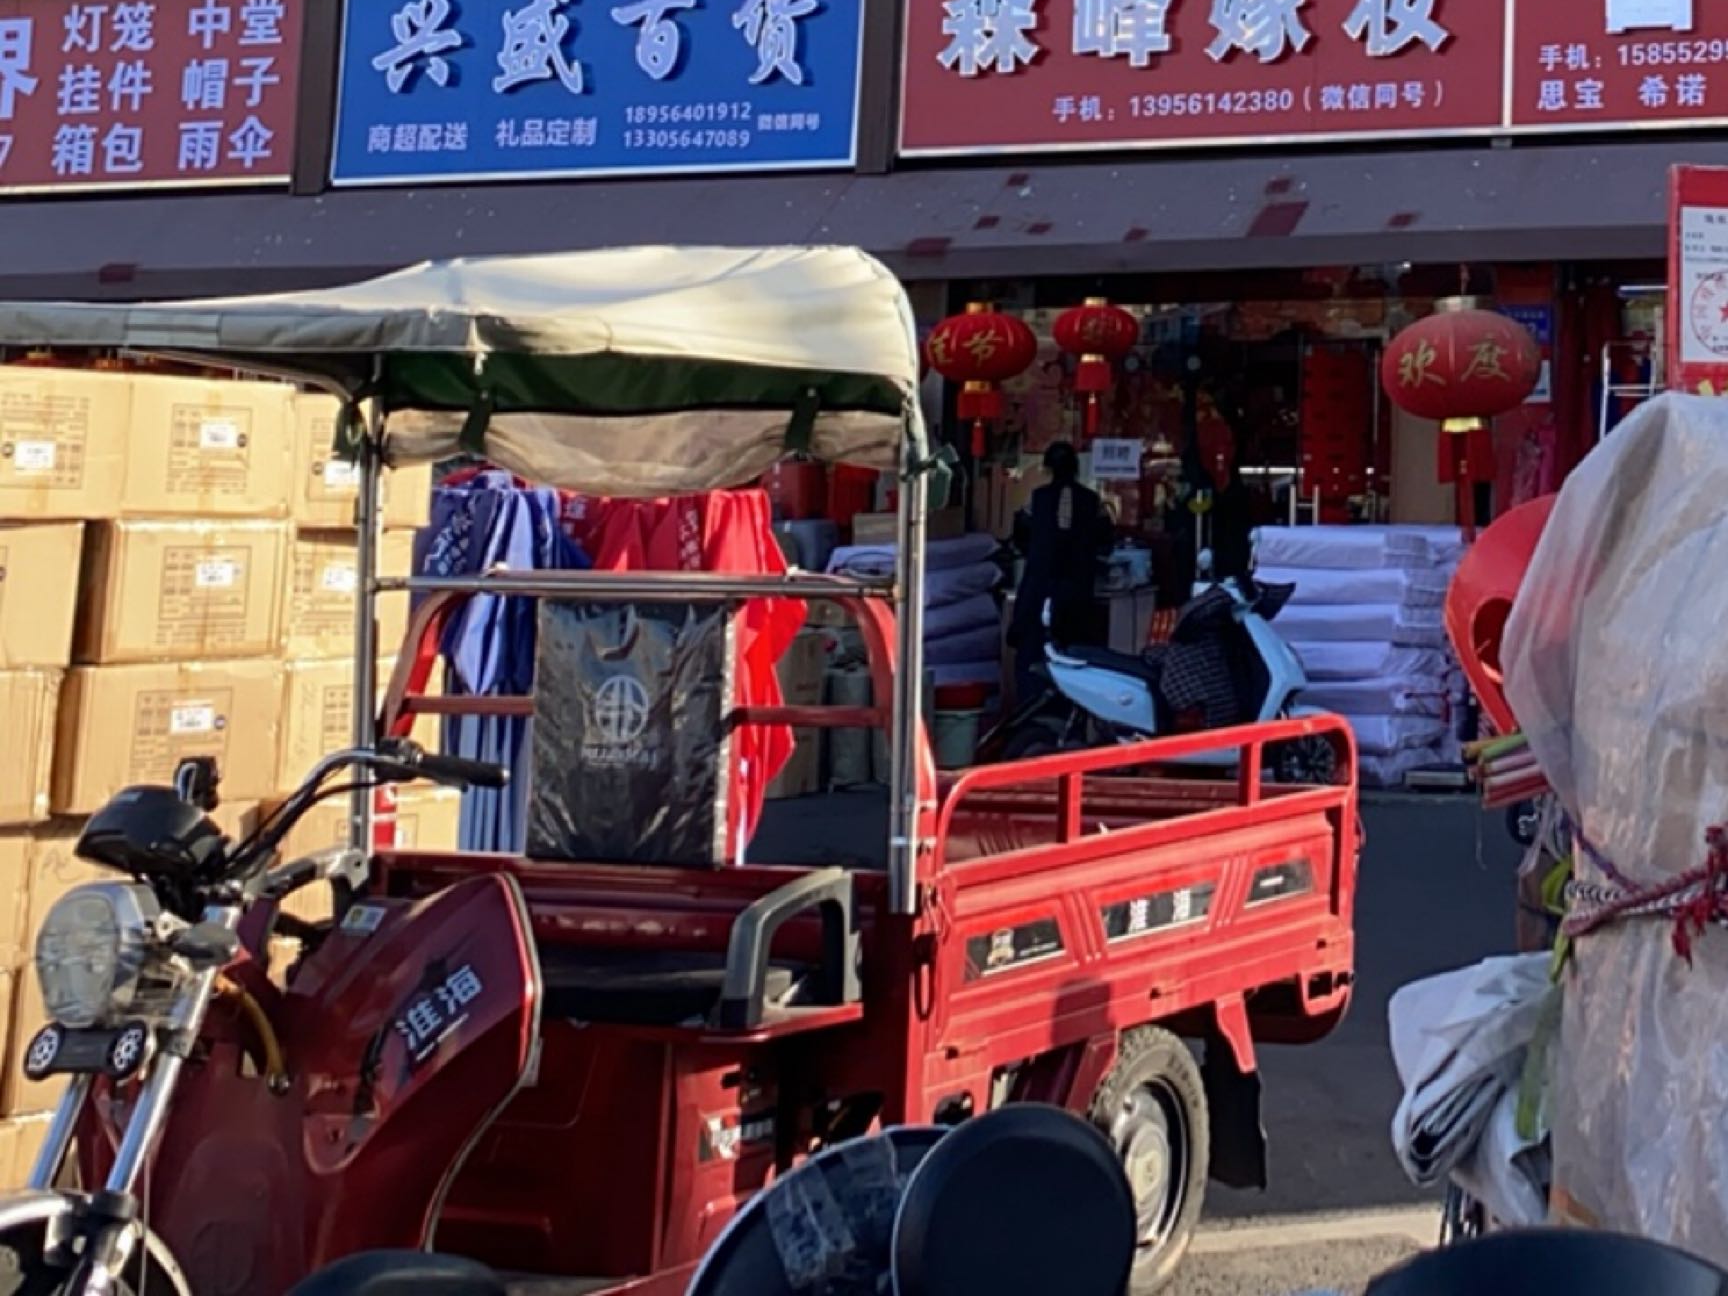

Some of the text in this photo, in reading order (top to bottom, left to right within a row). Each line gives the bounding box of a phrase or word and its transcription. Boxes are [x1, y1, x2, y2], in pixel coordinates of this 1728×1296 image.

[61, 1, 156, 53] 灯笼
[57, 56, 280, 116] 挂件 帽子
[1537, 78, 1605, 110] 思宝
[1637, 74, 1706, 107] 希诺
[366, 115, 599, 154] 商超配送 礼品定制
[624, 101, 752, 125] 18956401912
[51, 114, 274, 176] 箱包 雨伞
[623, 127, 752, 149] 13305647089
[1397, 332, 1513, 390] 欢度
